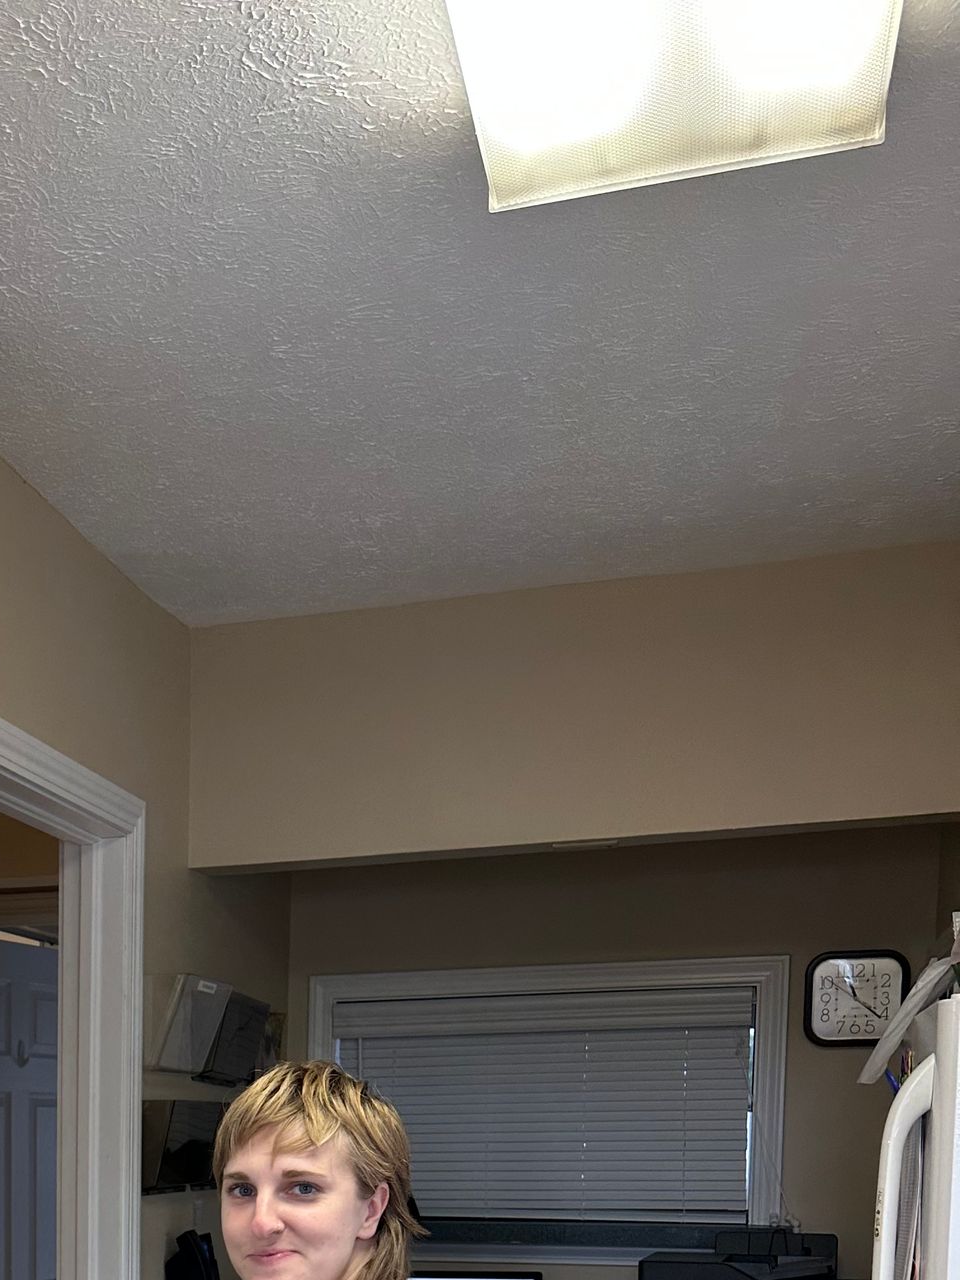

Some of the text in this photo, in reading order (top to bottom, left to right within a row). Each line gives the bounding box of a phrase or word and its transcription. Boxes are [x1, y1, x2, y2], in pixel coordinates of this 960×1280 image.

[871, 963, 877, 978] 1
[819, 976, 834, 991] 10
[880, 973, 891, 988] 2
[820, 993, 832, 1006] 9
[880, 992, 890, 1006] 3
[820, 1008, 831, 1023] 8
[879, 1007, 889, 1021] 4
[836, 1020, 846, 1034] 7
[849, 1020, 861, 1034] 6
[864, 1020, 876, 1034] 5
